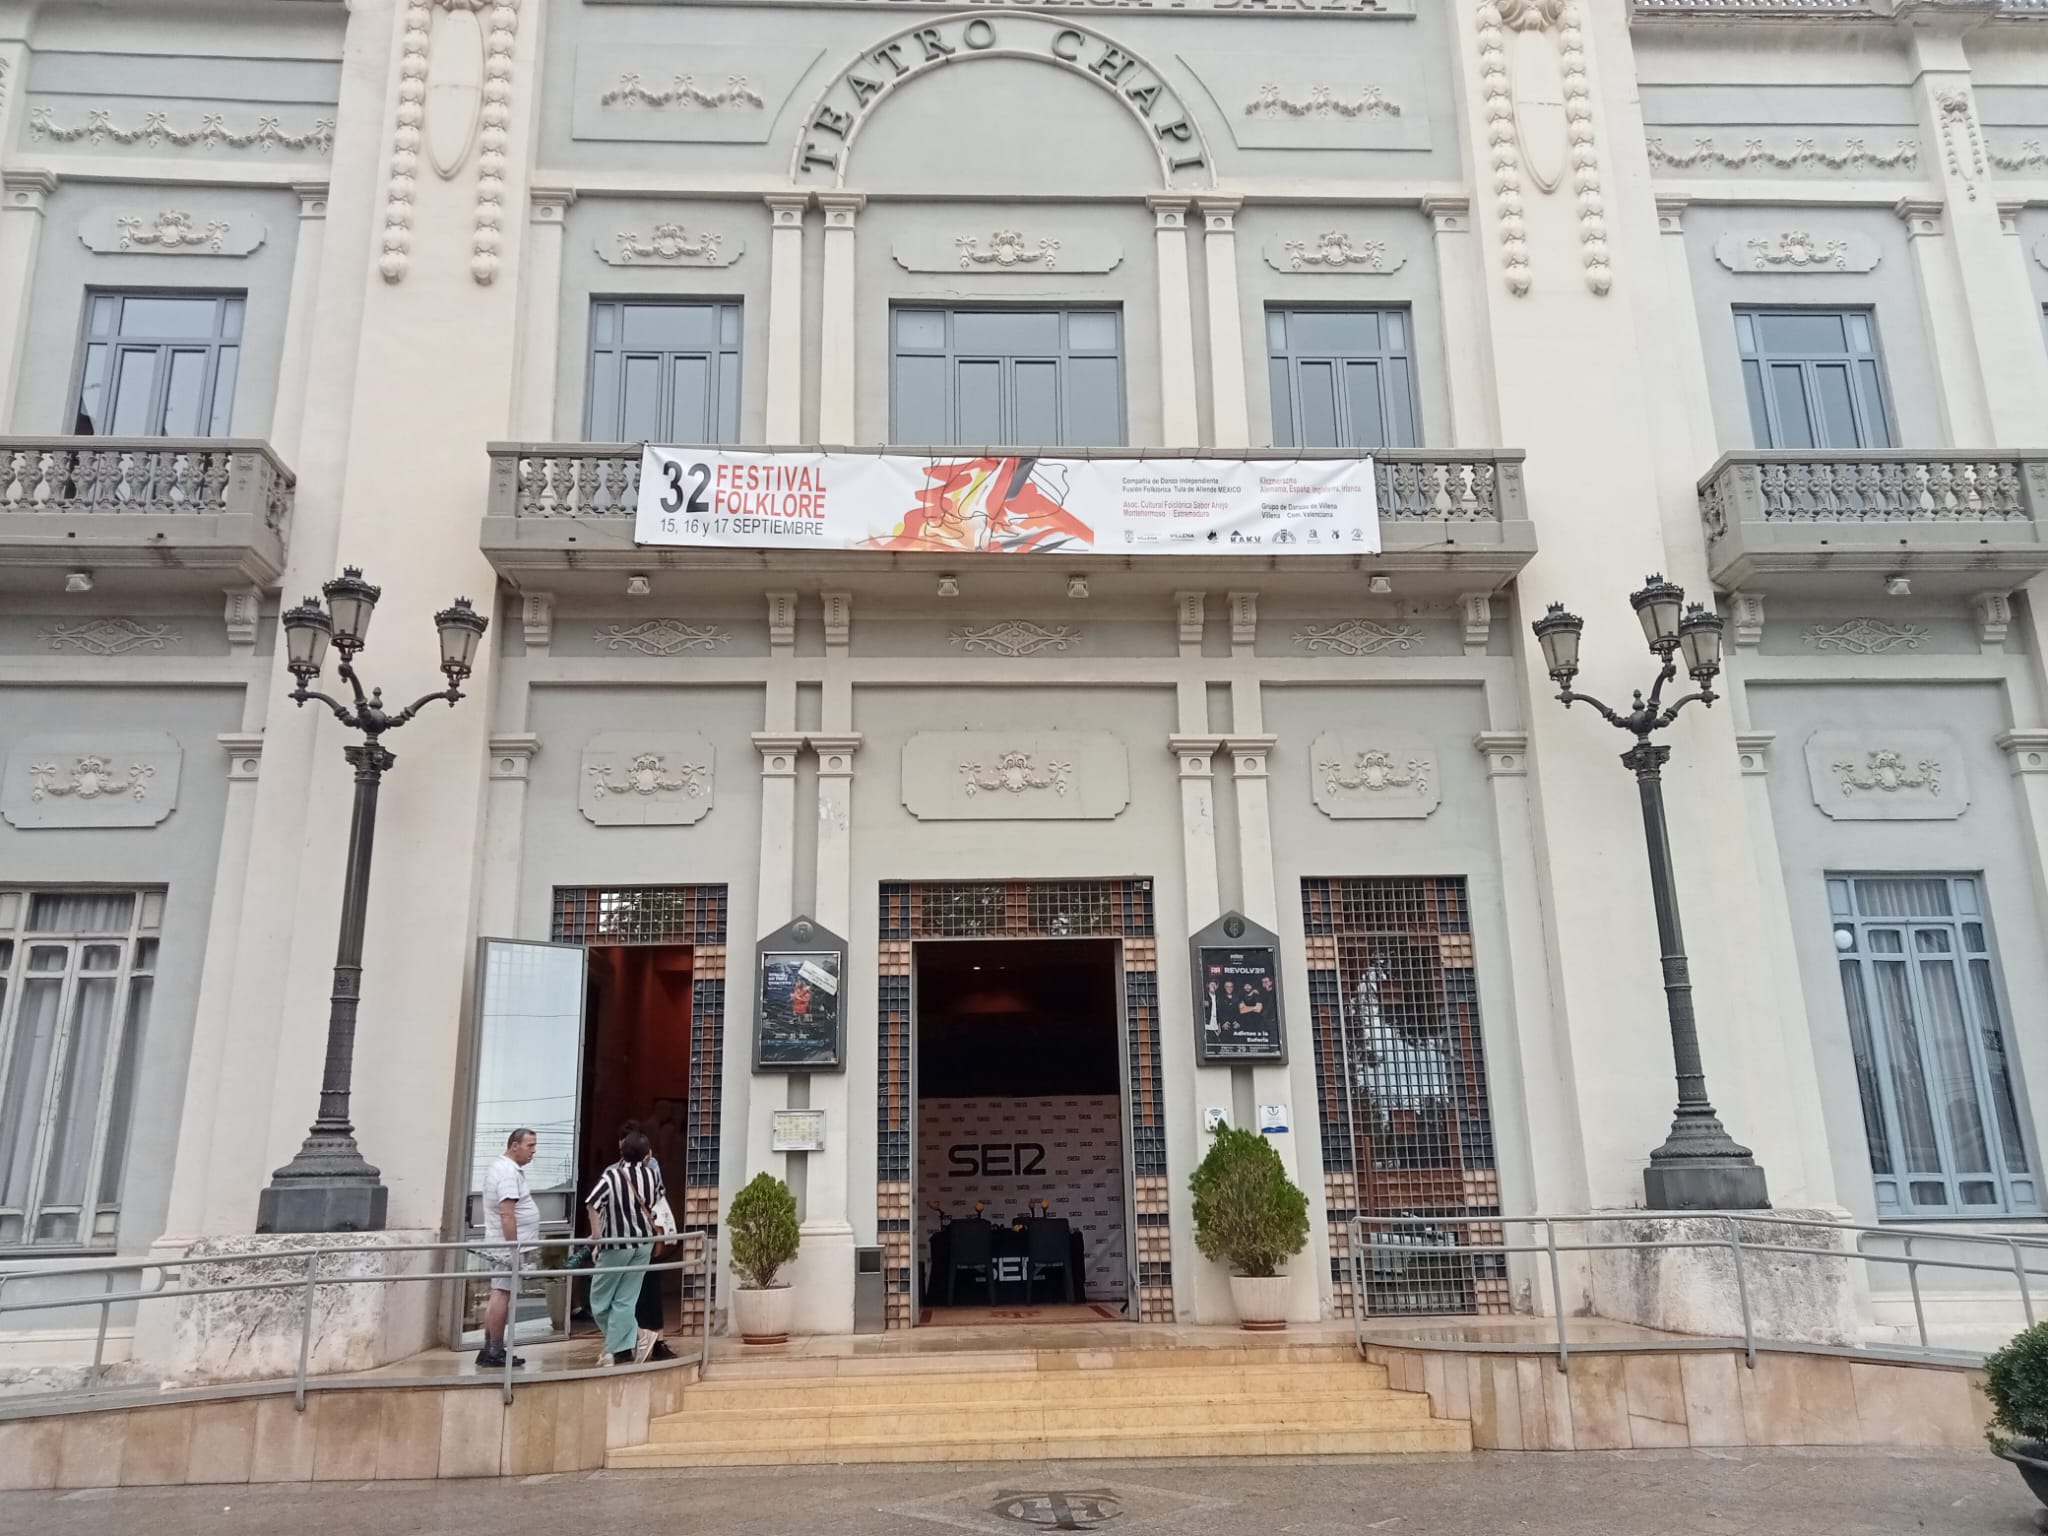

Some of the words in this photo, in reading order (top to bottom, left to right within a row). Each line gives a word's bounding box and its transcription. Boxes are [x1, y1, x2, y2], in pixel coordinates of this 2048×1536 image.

[802, 17, 997, 173] TEATRO
[1051, 28, 1206, 172] CHAPI
[660, 460, 712, 514] 32
[717, 464, 827, 492] FESTIVAL
[714, 490, 826, 519] FOLKLORE
[660, 518, 678, 534] 15,
[684, 519, 698, 534] 16
[702, 524, 709, 538] y
[714, 518, 728, 534] 17
[732, 518, 824, 536] SEPTIEMBRE
[948, 1142, 1046, 1178] SER
